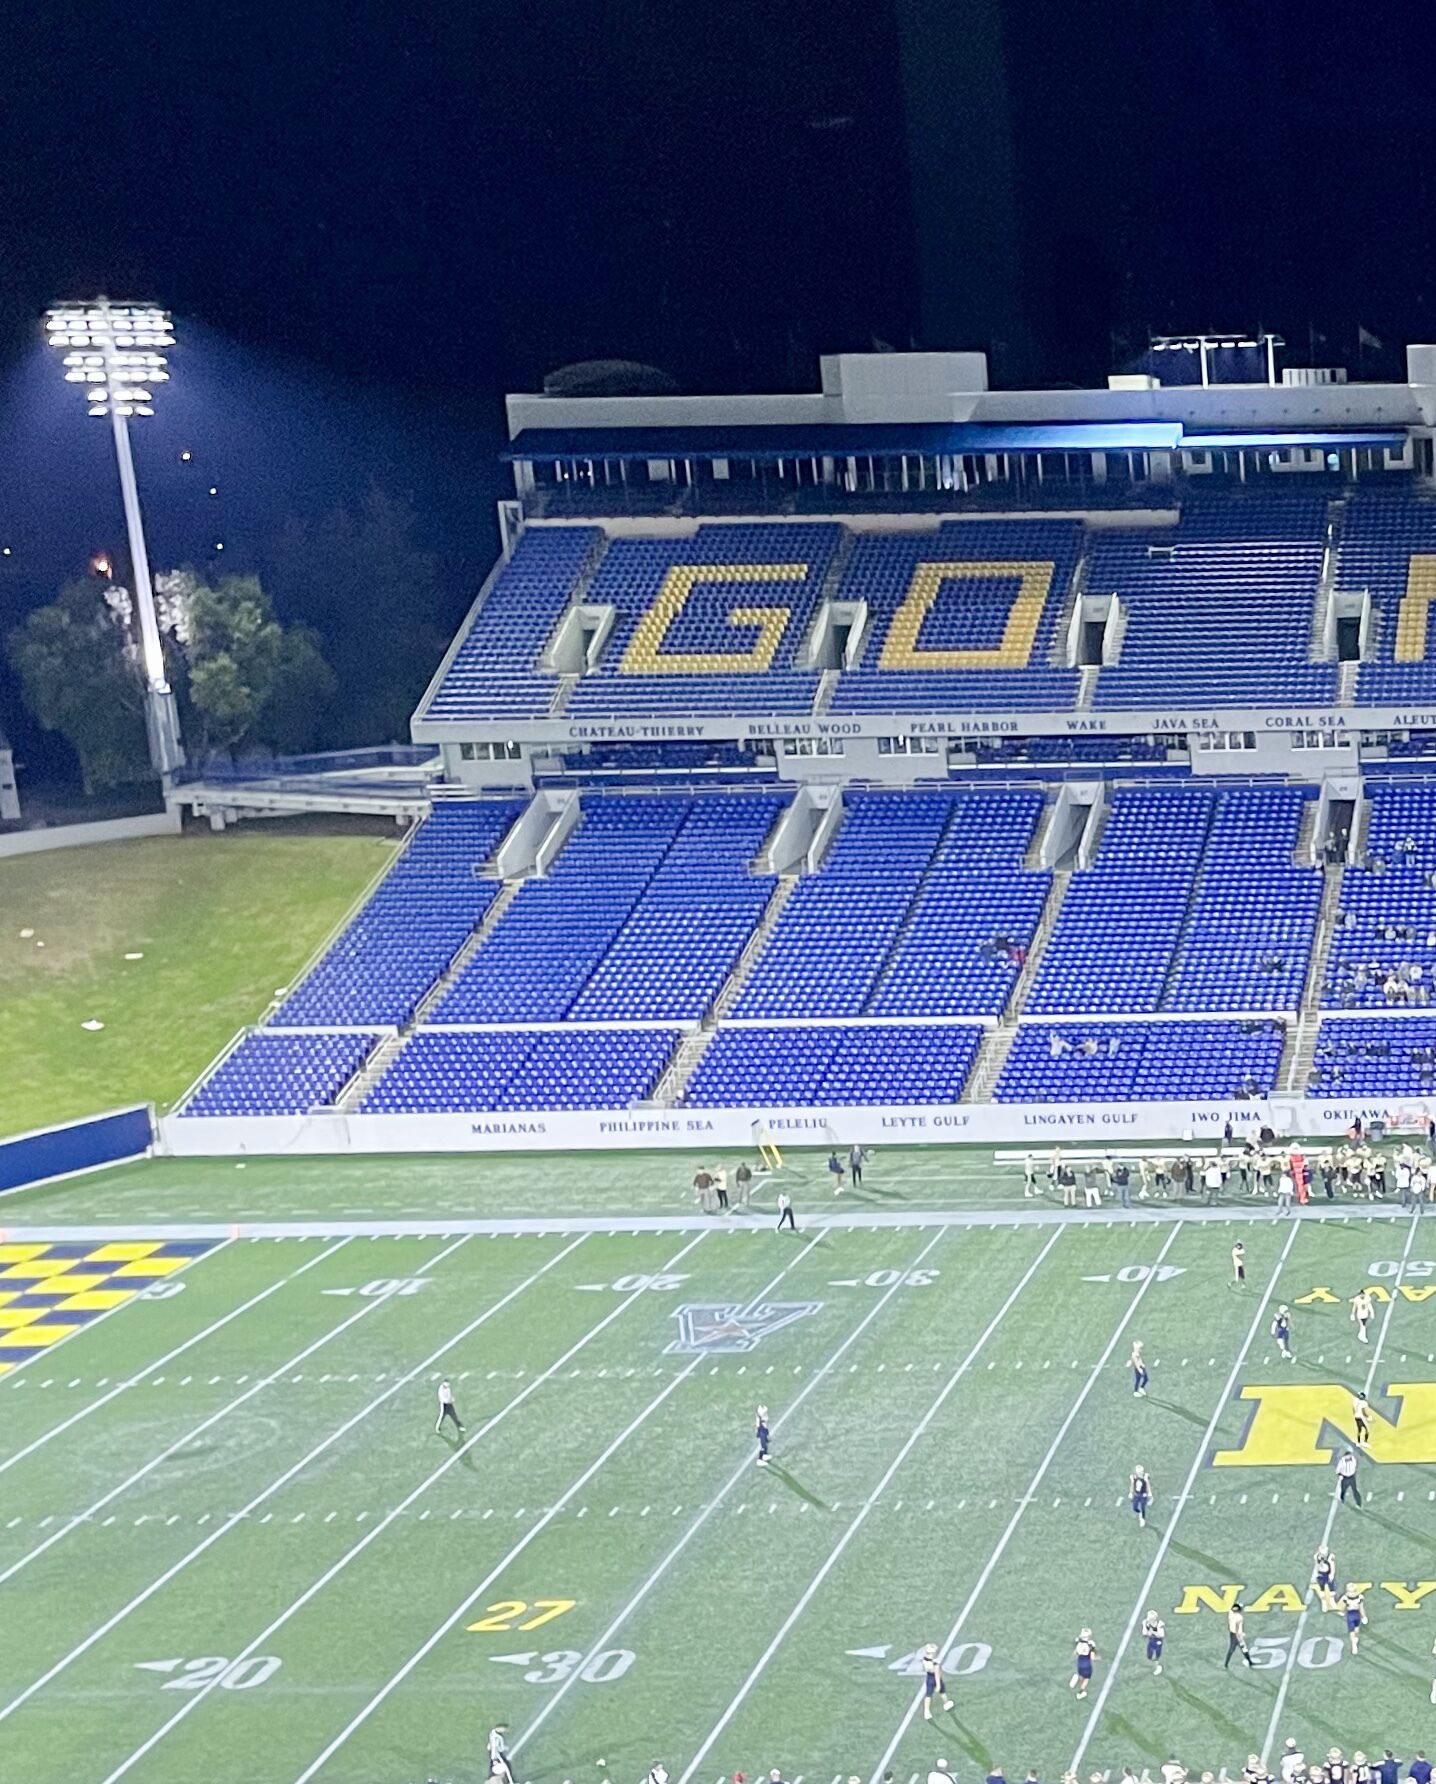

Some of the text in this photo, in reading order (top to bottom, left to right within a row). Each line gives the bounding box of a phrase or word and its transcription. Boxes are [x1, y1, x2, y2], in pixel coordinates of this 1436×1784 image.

[619, 560, 1056, 674] GO
[911, 722, 1017, 733] PEARL HARBOR
[1067, 721, 1105, 730] WAKE
[1153, 719, 1218, 729] JAVA SEA
[1266, 717, 1345, 727] CORAL SEA
[749, 724, 861, 735] BELLEAU WOOD
[882, 1117, 968, 1128] LEYTE GULF
[1025, 1114, 1137, 1125] LINGAYEN GULF
[1192, 1112, 1260, 1122] IWO JIMA
[472, 1124, 545, 1134] MARIANAS
[600, 1121, 712, 1132] PHILIPPINE SEA
[769, 1119, 826, 1129] PELELIU
[465, 1599, 577, 1632] 27
[1248, 1636, 1344, 1670] 50
[888, 1642, 993, 1676] 40
[523, 1649, 637, 1685] 30
[160, 1656, 283, 1690] 20
